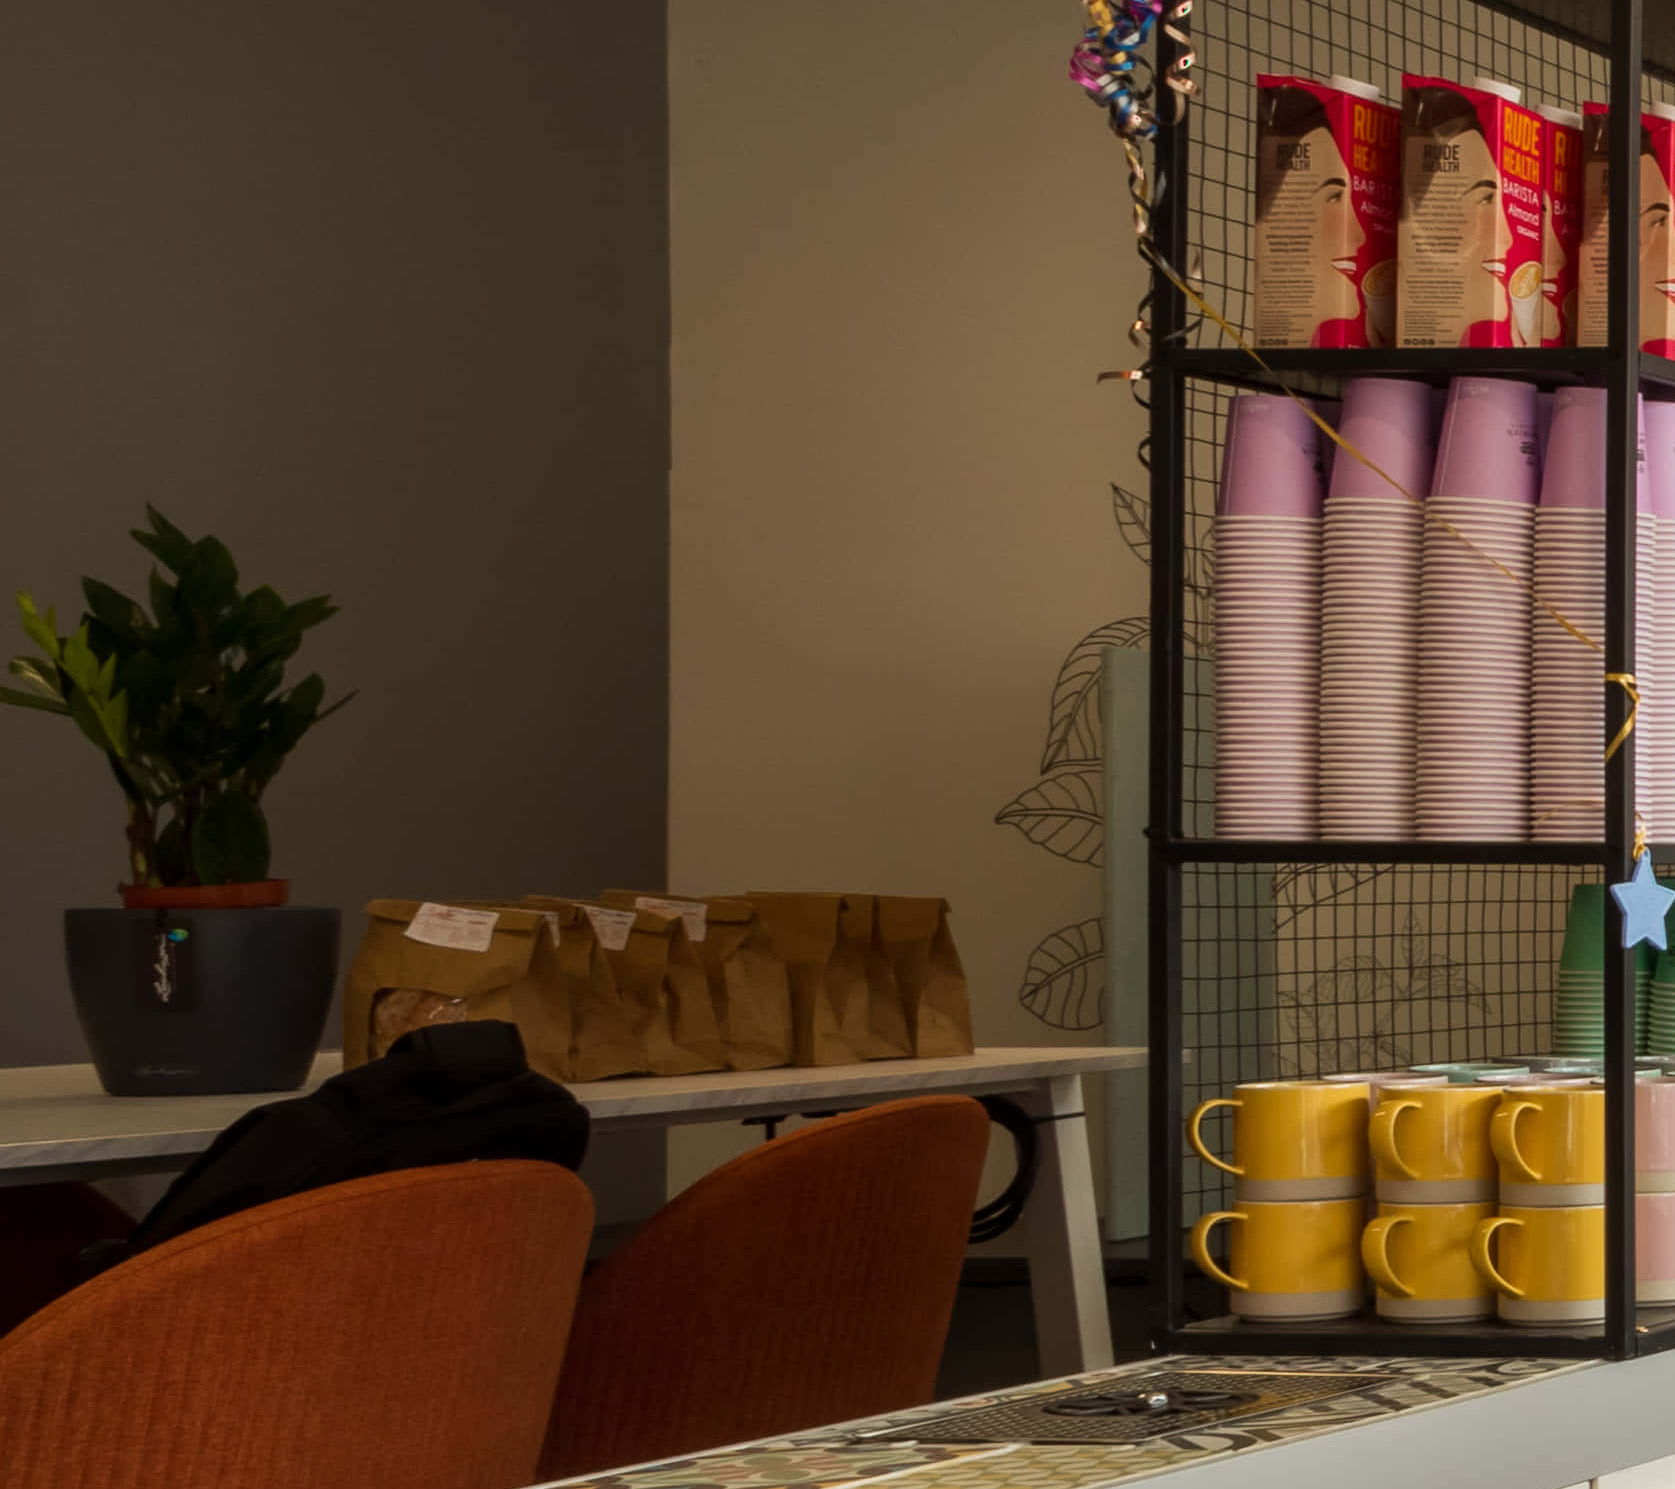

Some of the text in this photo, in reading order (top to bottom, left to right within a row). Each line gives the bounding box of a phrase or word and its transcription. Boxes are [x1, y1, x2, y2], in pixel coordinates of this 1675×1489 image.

[1502, 106, 1542, 156] RUDE
[1423, 143, 1460, 161] RUDE
[1502, 151, 1540, 185] HEALTH
[1502, 177, 1540, 207] BARISTA
[1507, 203, 1540, 226] Almond
